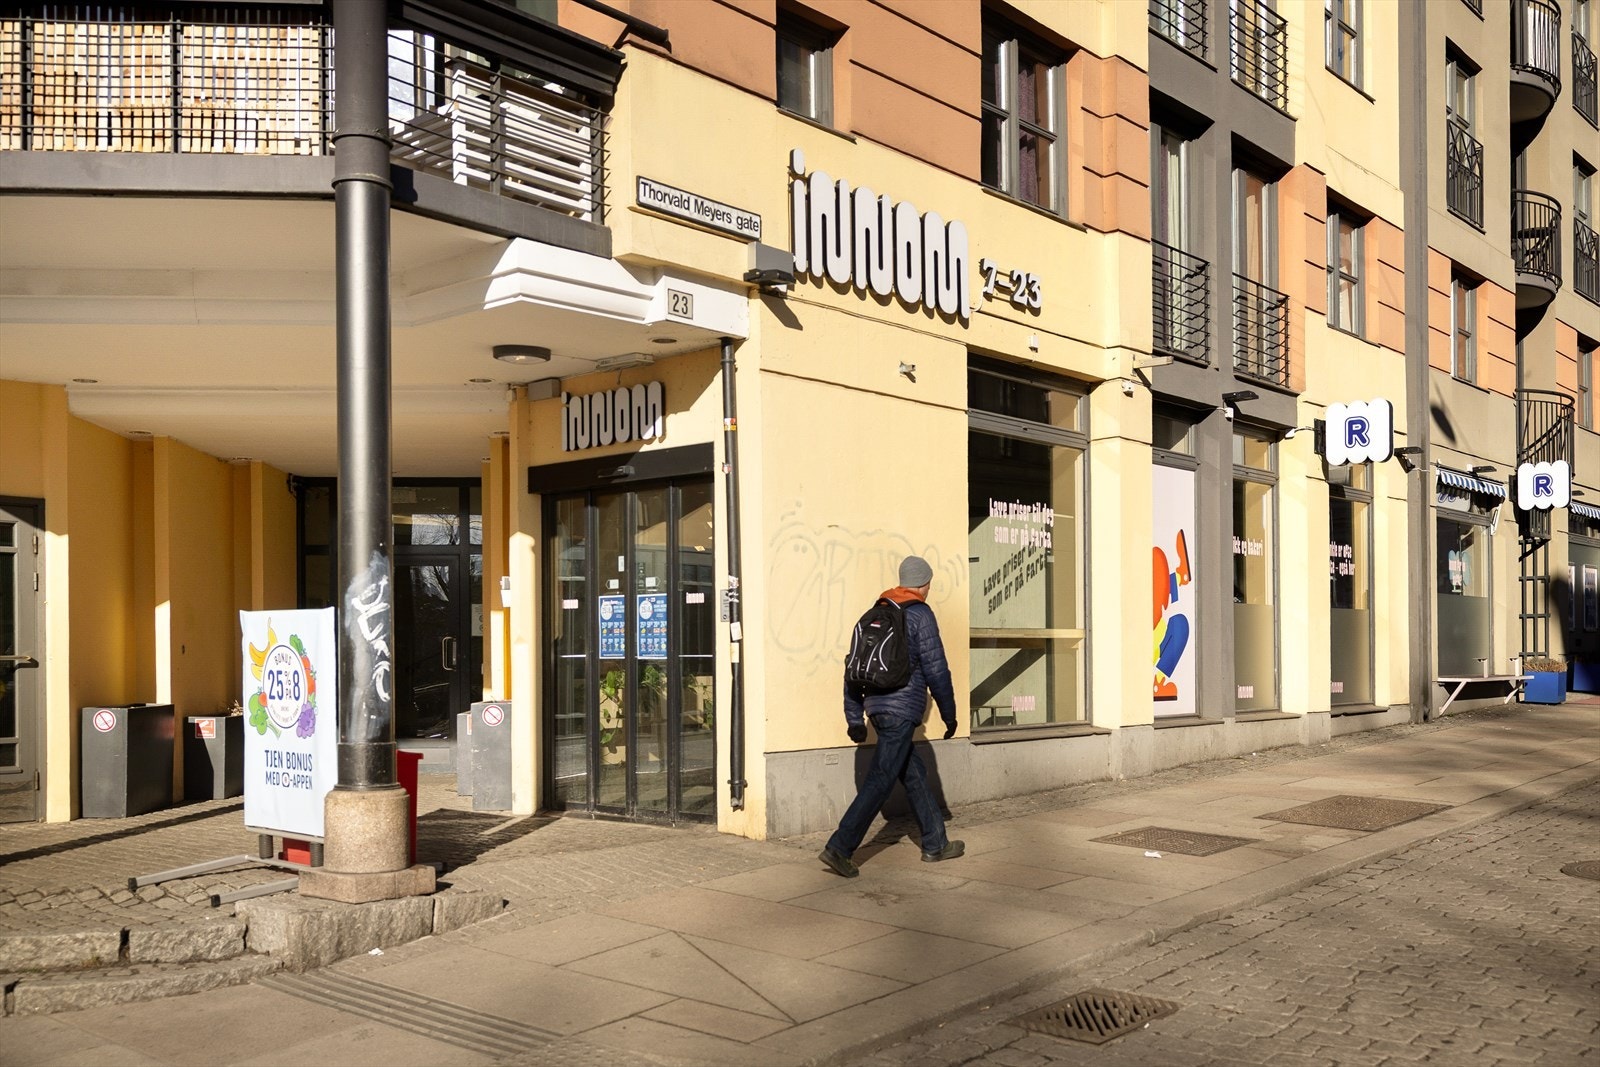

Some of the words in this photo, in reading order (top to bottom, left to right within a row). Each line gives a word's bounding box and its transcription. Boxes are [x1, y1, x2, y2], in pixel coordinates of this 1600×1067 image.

[641, 181, 691, 211] Thorvald
[694, 198, 732, 224] Meyers
[736, 215, 759, 232] gate
[672, 293, 689, 315] 23
[1345, 416, 1370, 448] R
[1533, 473, 1553, 497] R
[989, 497, 1008, 519] Lave
[1009, 499, 1031, 524] priser
[1032, 502, 1041, 523] til
[994, 526, 1009, 544] som
[1010, 527, 1018, 545] er
[1020, 523, 1029, 550] på
[274, 652, 292, 666] BONUS
[267, 669, 284, 701] 25
[292, 669, 301, 701] 8
[264, 749, 283, 769] TJEN
[286, 751, 313, 772] BONUS
[265, 770, 280, 786] MED
